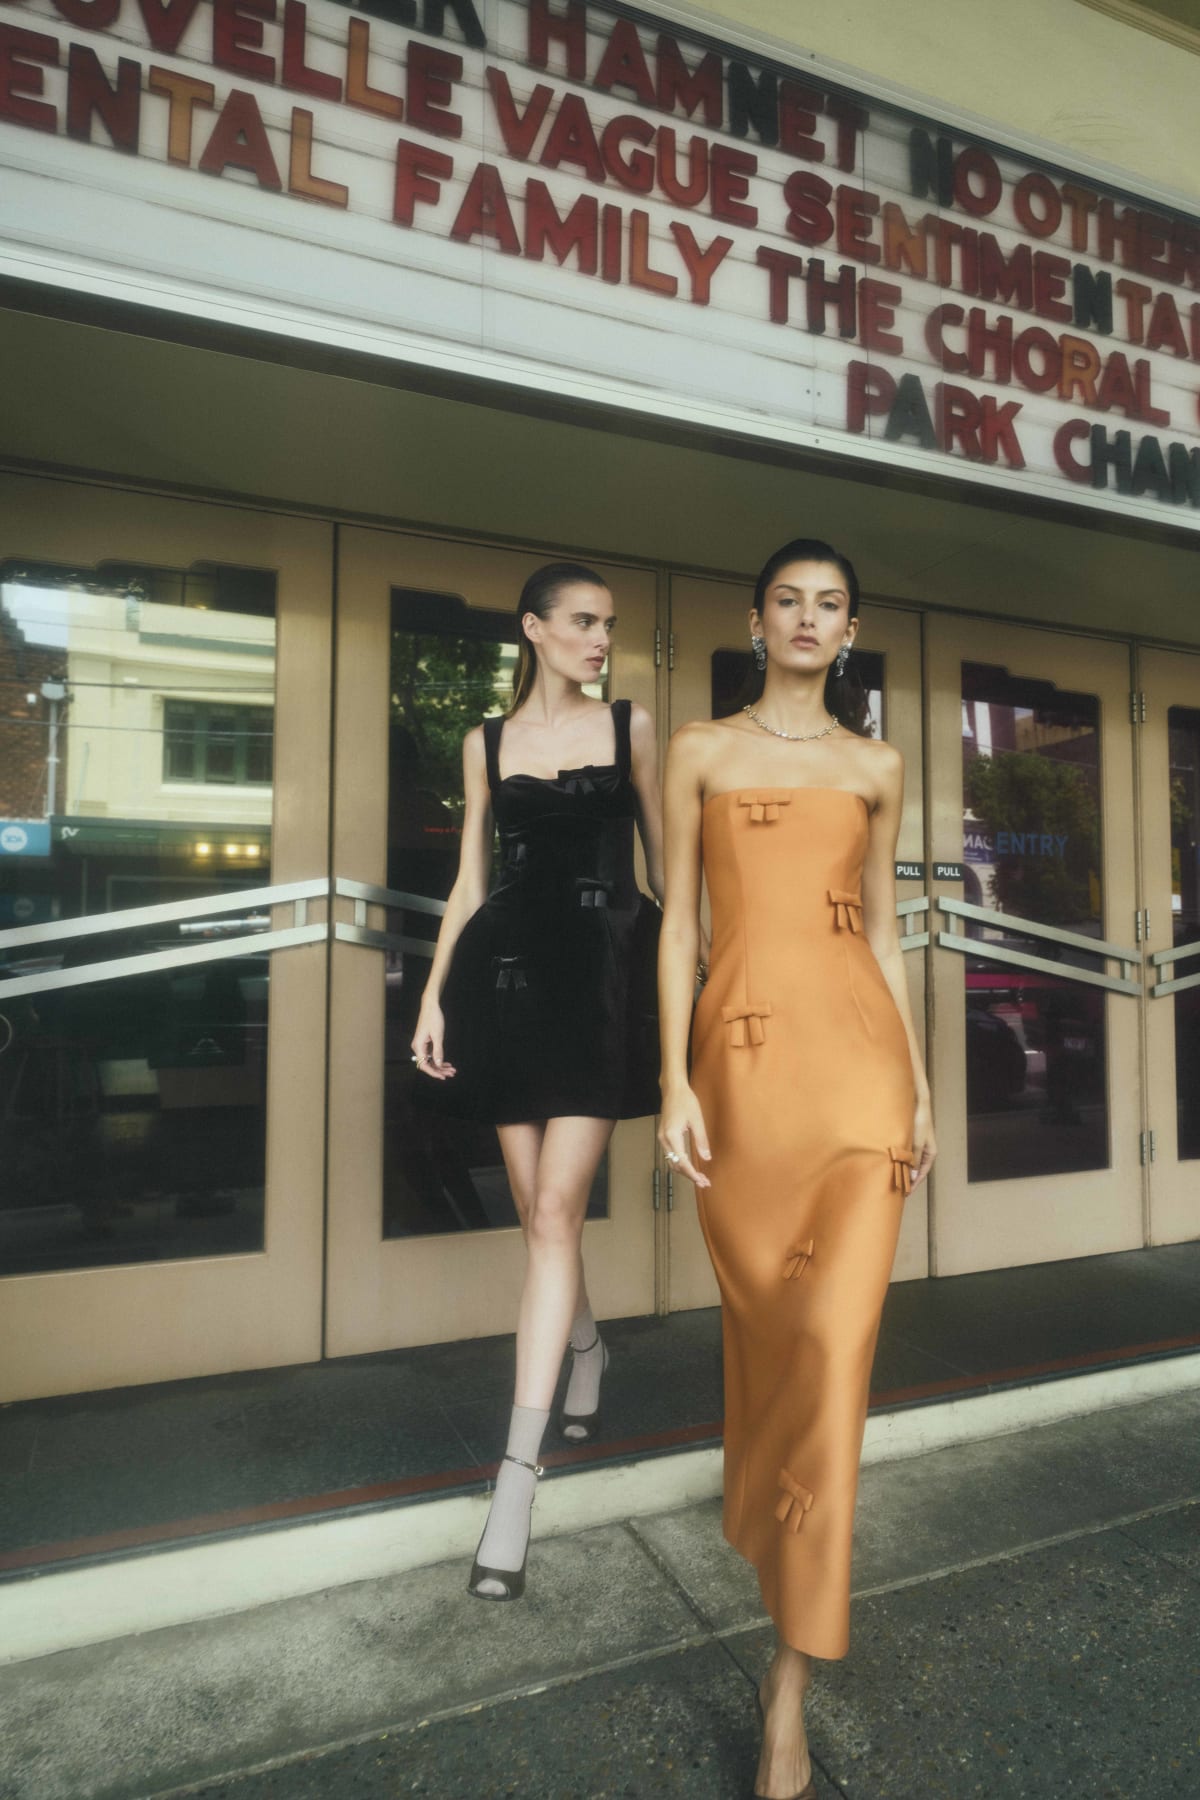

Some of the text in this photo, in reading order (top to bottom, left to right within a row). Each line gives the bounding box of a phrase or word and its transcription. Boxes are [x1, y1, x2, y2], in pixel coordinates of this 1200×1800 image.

[54, 0, 463, 138] VELLE
[485, 65, 758, 229] VAGUE
[528, 0, 869, 173] HAMNET
[908, 128, 1003, 218] NO
[0, 22, 1171, 427] ENTAL FAMILY THE CHORAL
[846, 359, 1200, 509] PARK CHAN
[896, 865, 920, 876] PULL
[937, 866, 961, 877] PULL
[996, 831, 1069, 857] ENTRY
